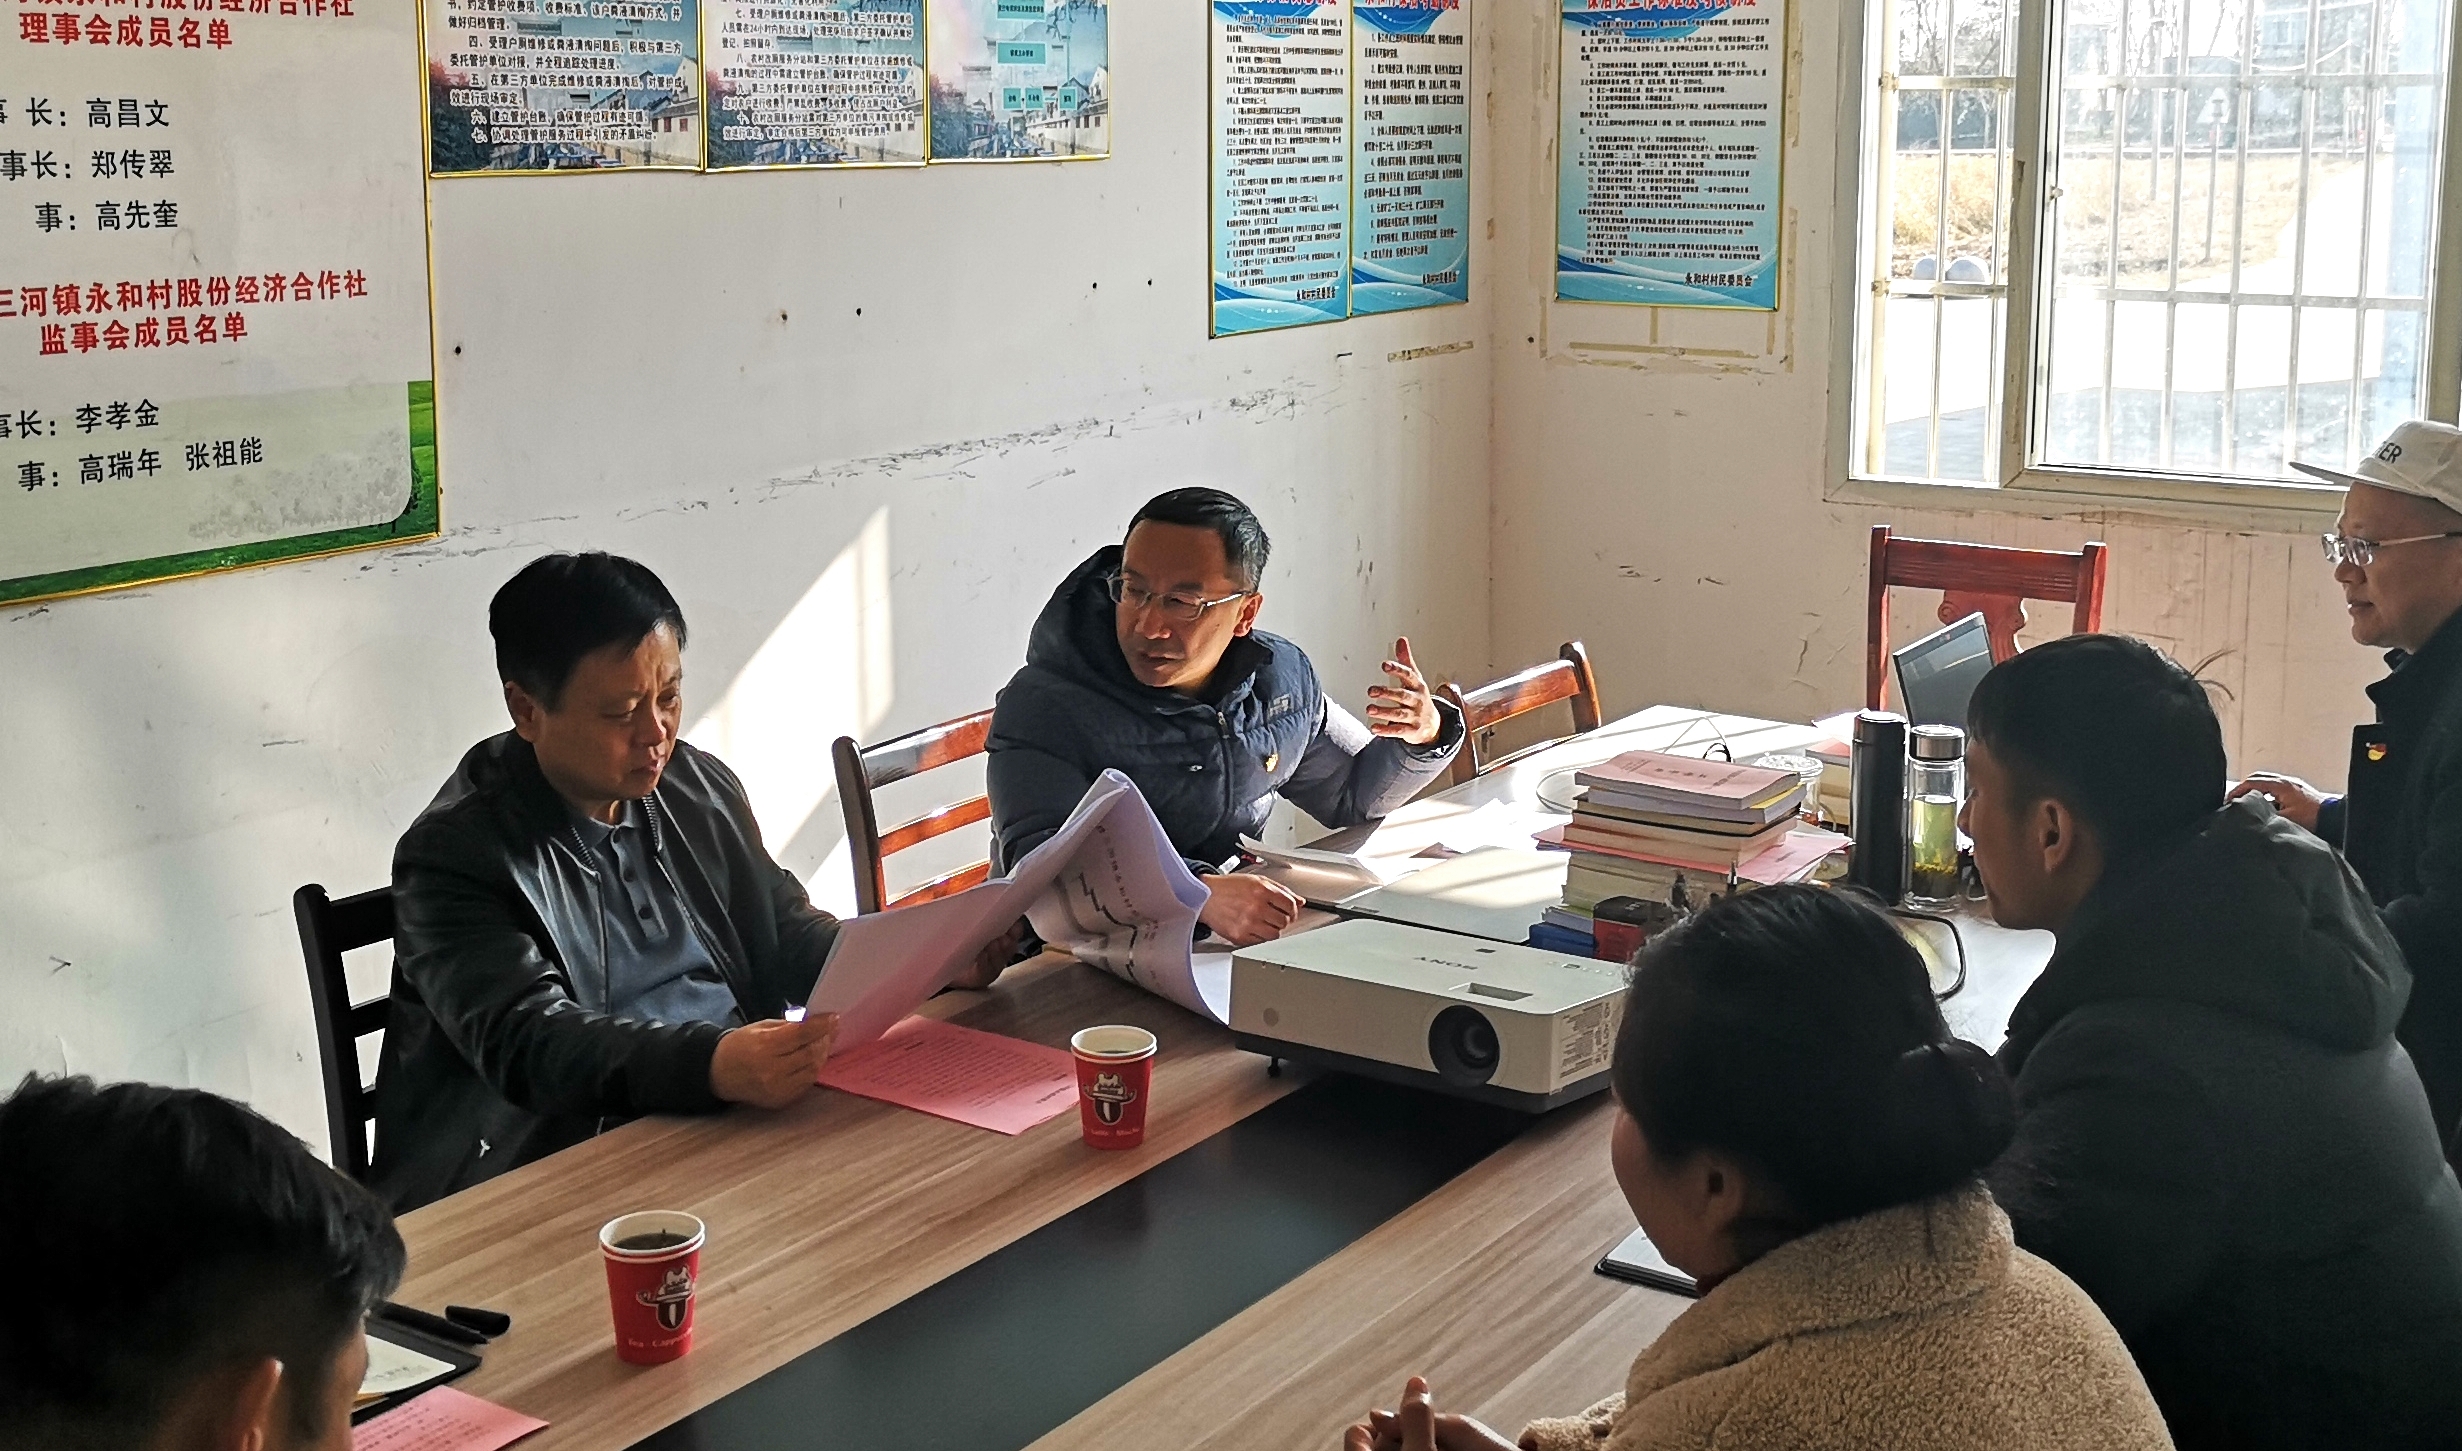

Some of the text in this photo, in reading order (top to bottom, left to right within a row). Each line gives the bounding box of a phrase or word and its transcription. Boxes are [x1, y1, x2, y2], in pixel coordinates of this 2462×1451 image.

[19, 12, 233, 50] 理事会成员名单
[0, 268, 369, 318] 三河镇永和村股份经济合作社
[39, 311, 249, 356] 监事会成员名单
[185, 436, 264, 473] 张祖能
[2375, 441, 2403, 464] ER
